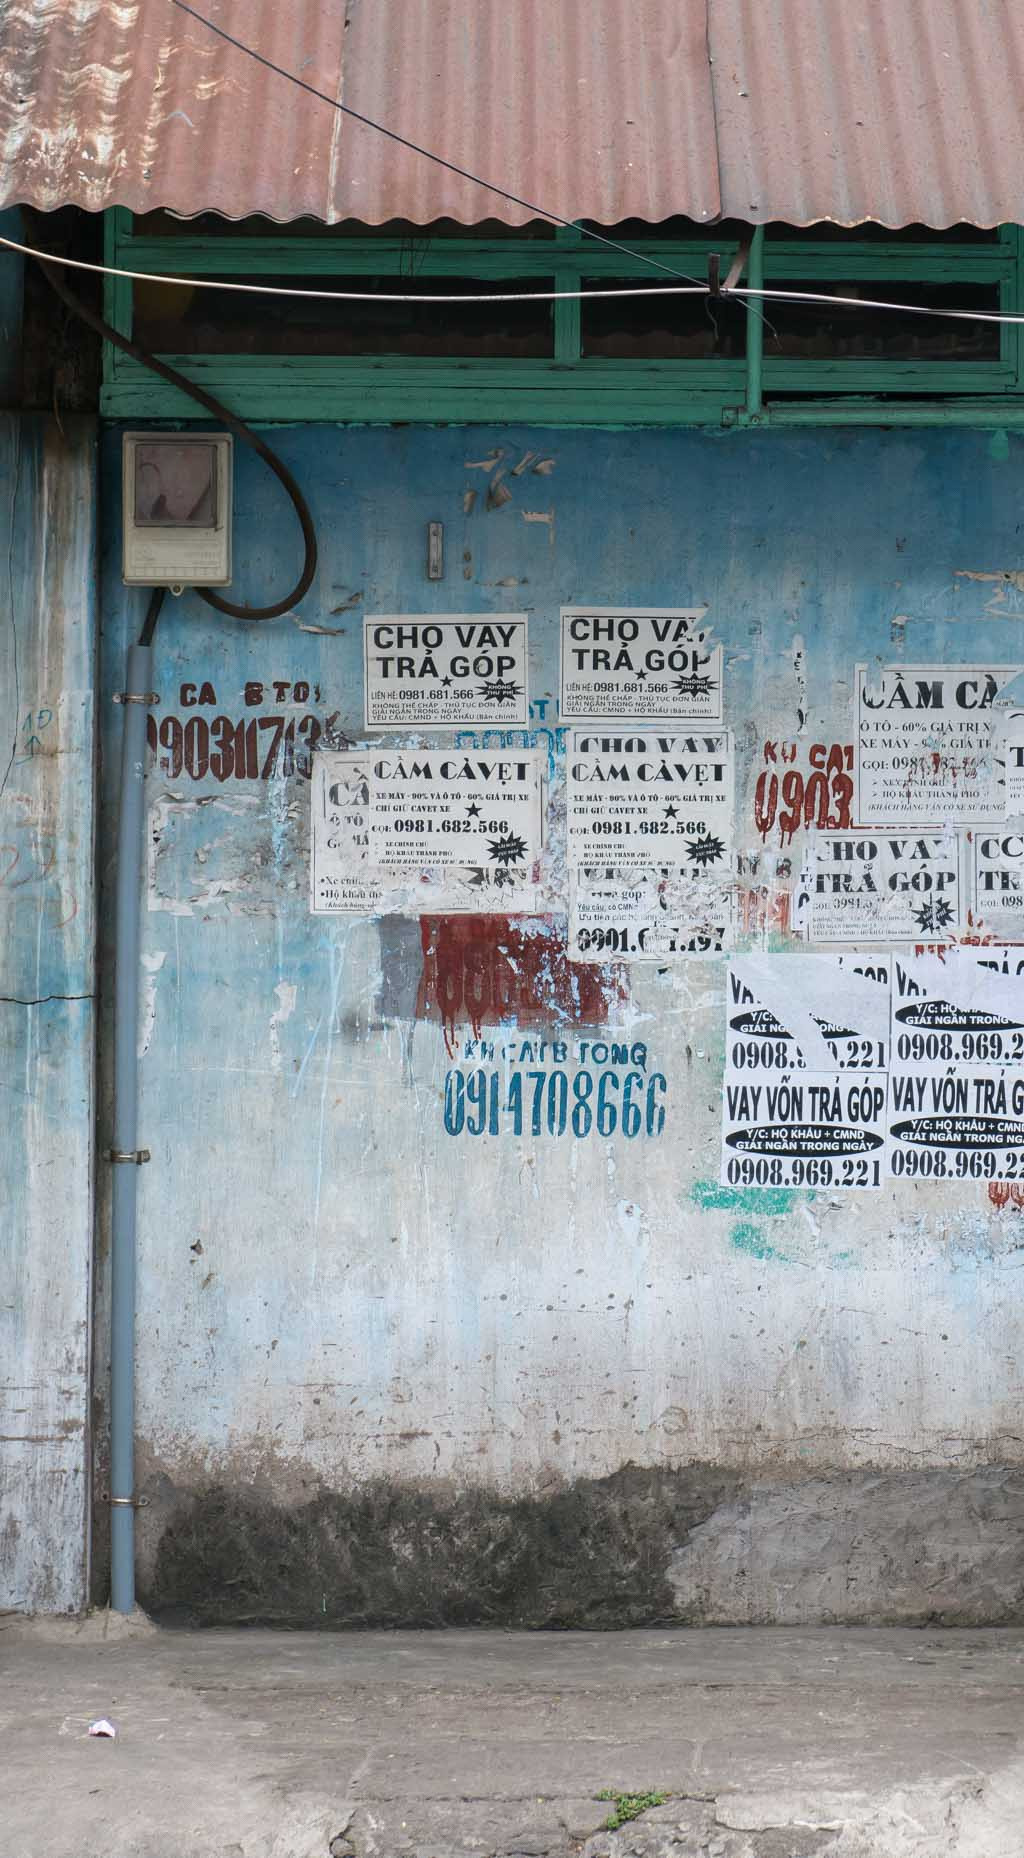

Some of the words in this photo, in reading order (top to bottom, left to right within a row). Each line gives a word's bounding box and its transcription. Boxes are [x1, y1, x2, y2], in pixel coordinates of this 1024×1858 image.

[373, 625, 443, 649] CHO
[455, 625, 518, 648] VAY
[569, 618, 639, 642] CHO
[376, 648, 439, 678] TRẢ
[449, 649, 516, 678] GÓP
[571, 641, 634, 671] TRẢ
[399, 689, 474, 700] 0981.681.566
[594, 682, 668, 693] 0981.681.566
[902, 722, 927, 732] 60%
[930, 720, 954, 732] GIÁ
[860, 739, 877, 749] XE
[881, 737, 910, 749] MÁY
[374, 755, 433, 781] CẦM
[571, 758, 630, 782] CẦM
[393, 819, 509, 834] 0981.682.566
[592, 821, 706, 835] 0981.682.566
[888, 863, 956, 893] GÓP
[916, 1003, 939, 1017] Y/C:
[969, 1015, 1009, 1025] TRONG
[727, 1085, 762, 1121] VAY
[766, 1074, 804, 1122] VỐN
[808, 1075, 843, 1122] TRẢ
[847, 1076, 885, 1123] GÓP
[892, 1076, 928, 1113] VAY
[931, 1067, 968, 1114] VỐN
[973, 1069, 1007, 1115] TRẢ
[444, 1069, 667, 1138] 0914708666
[911, 1119, 933, 1132] Y/C:
[746, 1128, 769, 1142] Y/C:
[833, 1129, 866, 1140] CMND
[964, 1133, 1004, 1144] TRONG
[800, 1141, 840, 1150] TRONG
[727, 1157, 880, 1187] 0908.969.221
